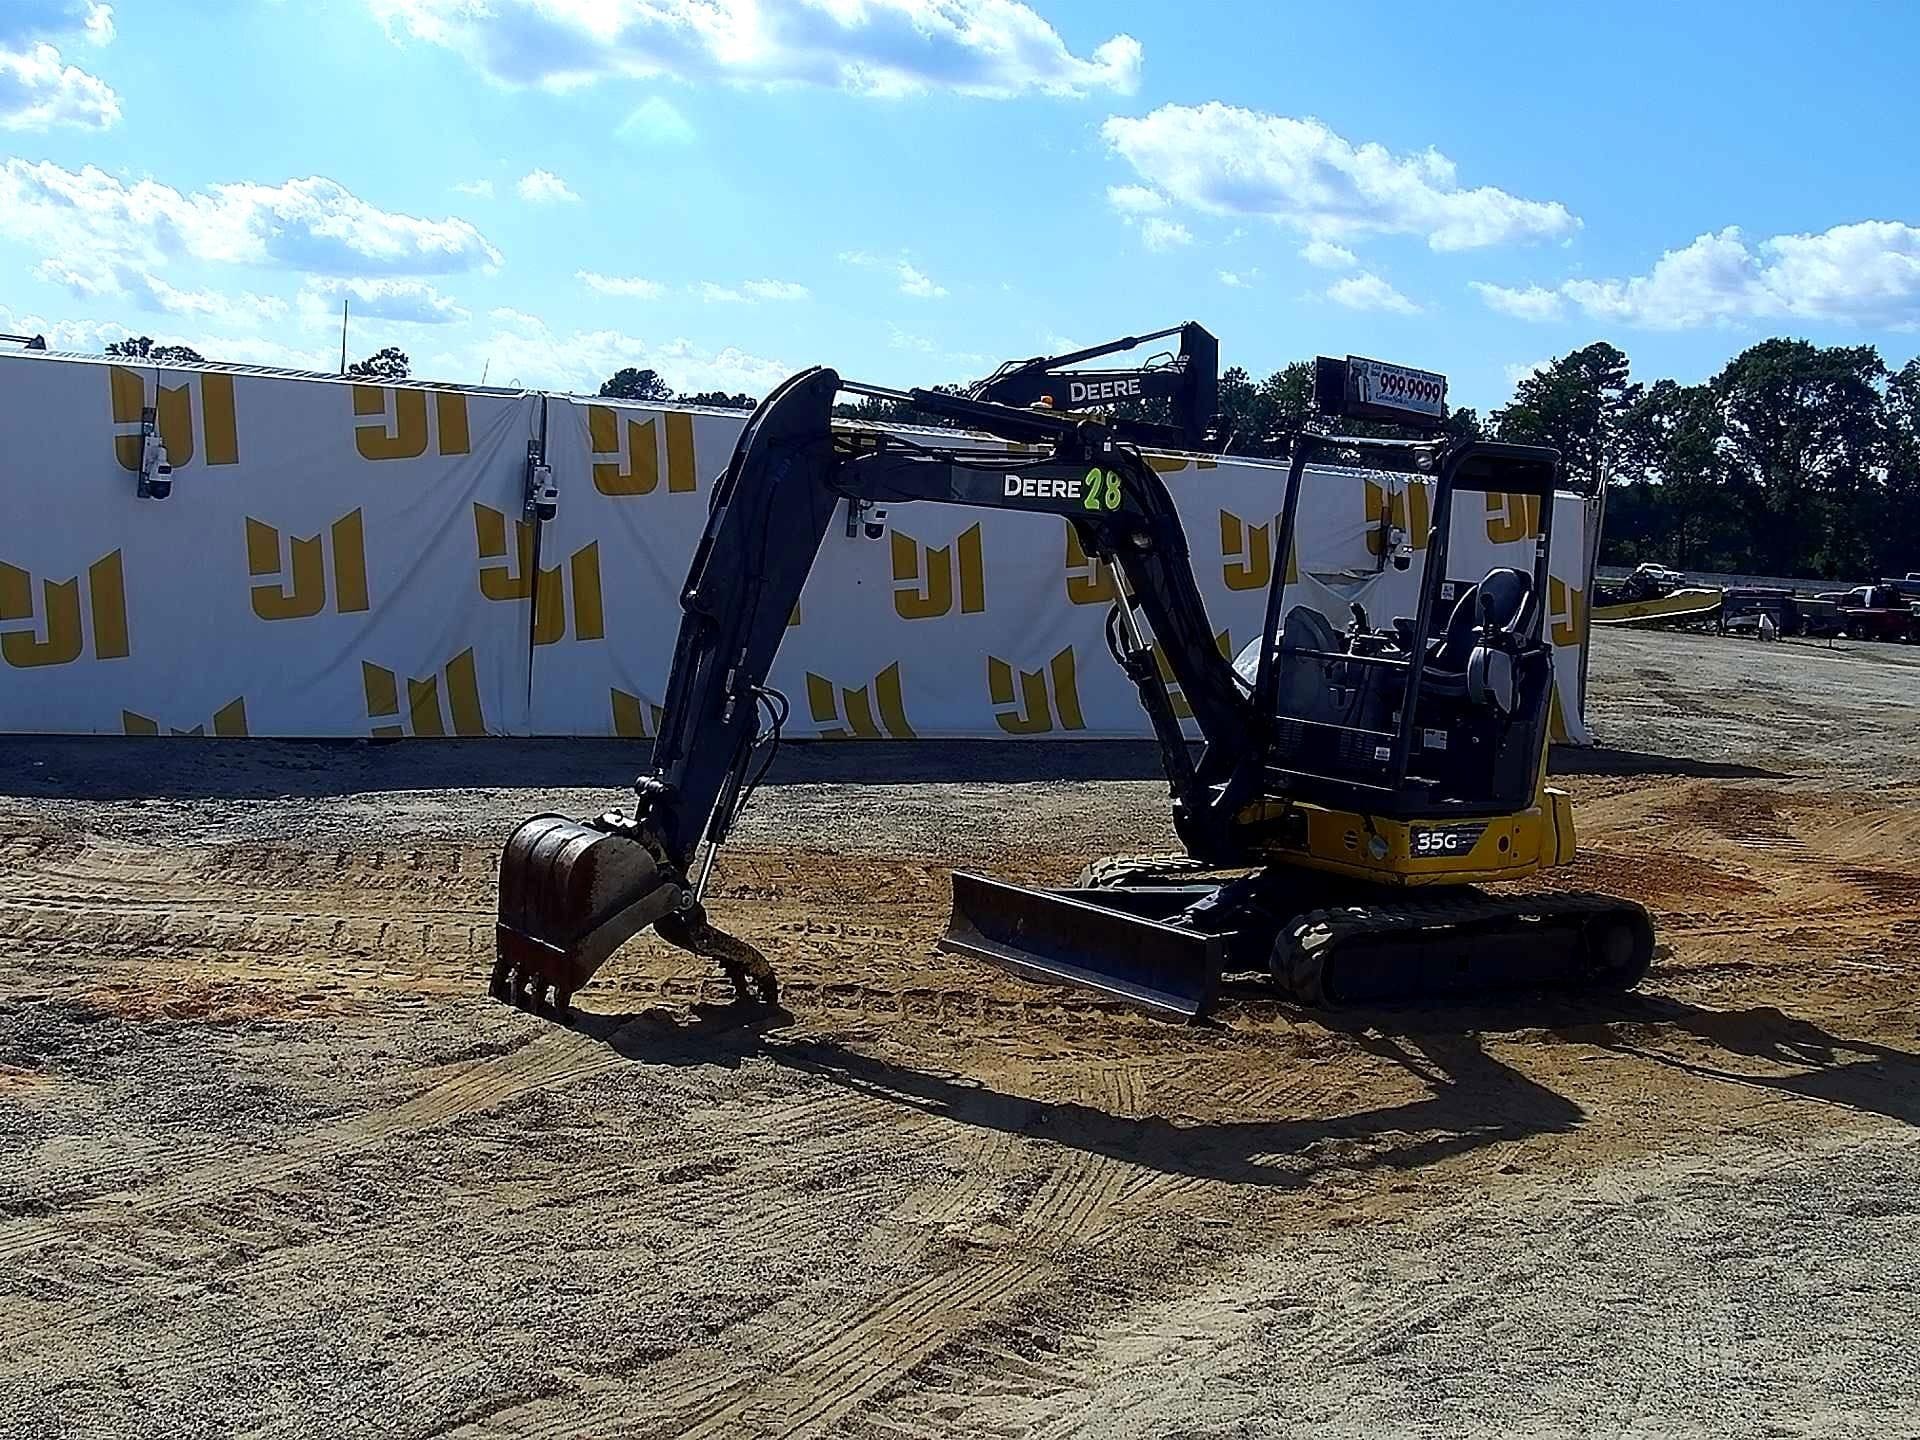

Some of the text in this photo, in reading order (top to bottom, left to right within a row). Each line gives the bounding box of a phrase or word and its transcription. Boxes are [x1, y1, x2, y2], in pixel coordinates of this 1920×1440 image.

[1069, 378, 1141, 402] DEERE
[1003, 474, 1082, 498] DEERE
[1083, 467, 1122, 511] 28
[1417, 832, 1458, 850] 35G
